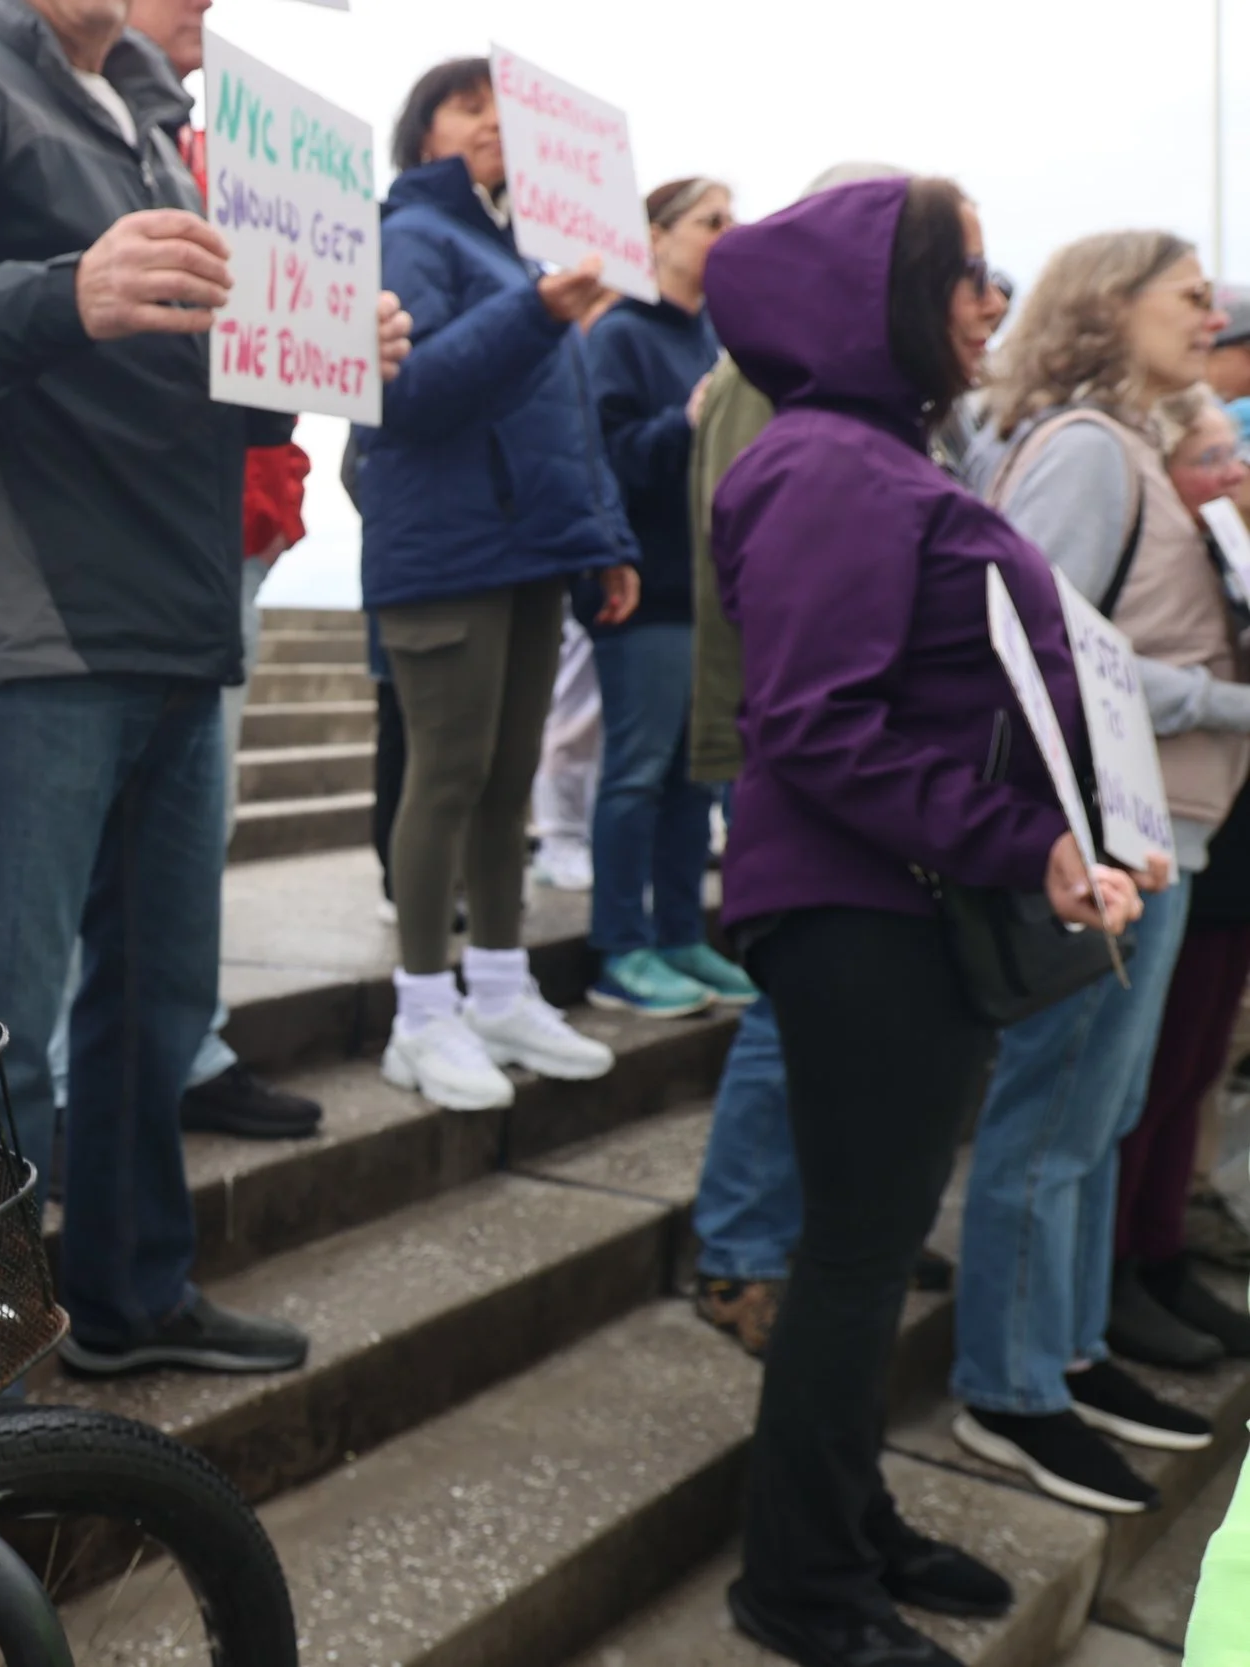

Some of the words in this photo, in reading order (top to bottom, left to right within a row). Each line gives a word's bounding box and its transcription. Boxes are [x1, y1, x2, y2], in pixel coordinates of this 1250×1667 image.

[214, 70, 278, 166] NYC
[289, 106, 375, 201] PARKS
[215, 168, 301, 243] SHOULD
[309, 209, 366, 265] GET
[266, 247, 313, 314] 1%
[327, 282, 356, 323] OF
[218, 318, 269, 380] THE
[276, 327, 369, 397] BUDGET
